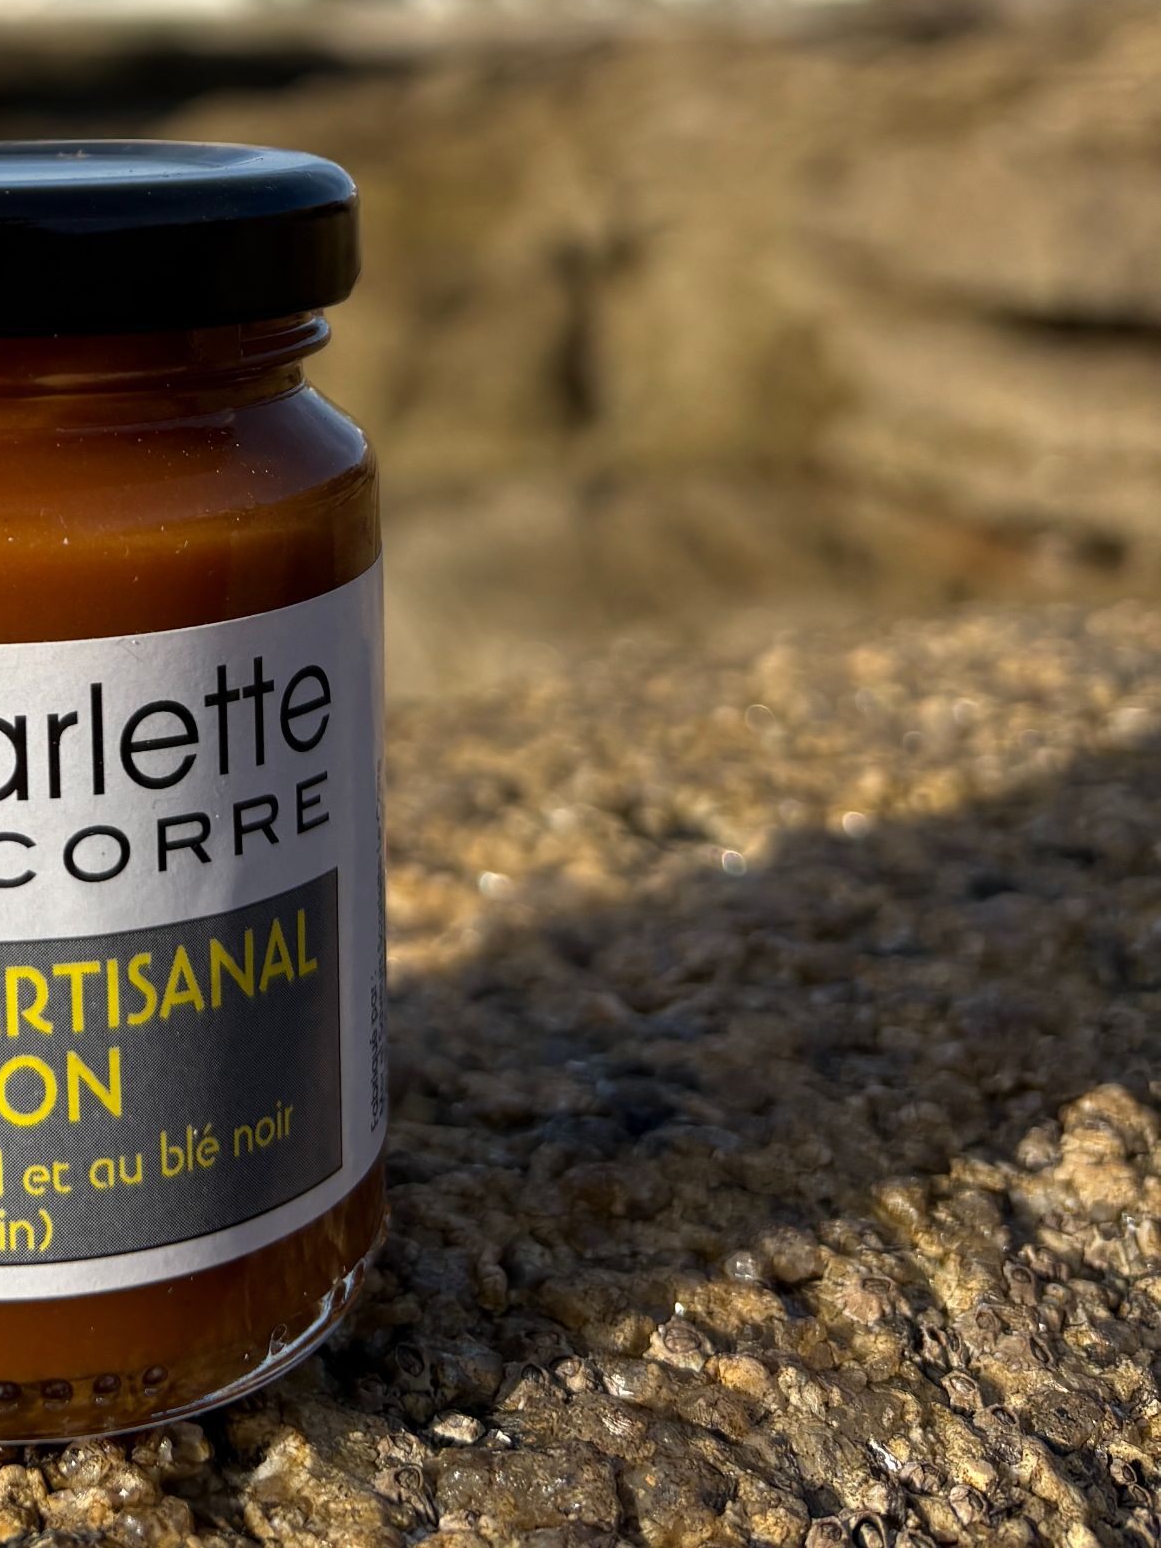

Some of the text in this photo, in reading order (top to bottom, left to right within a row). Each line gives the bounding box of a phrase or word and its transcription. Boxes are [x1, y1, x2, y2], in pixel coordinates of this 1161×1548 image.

[22, 1158, 73, 1199] et
[88, 1152, 144, 1193] au
[160, 1123, 221, 1178] blé
[233, 1100, 295, 1158] noir
